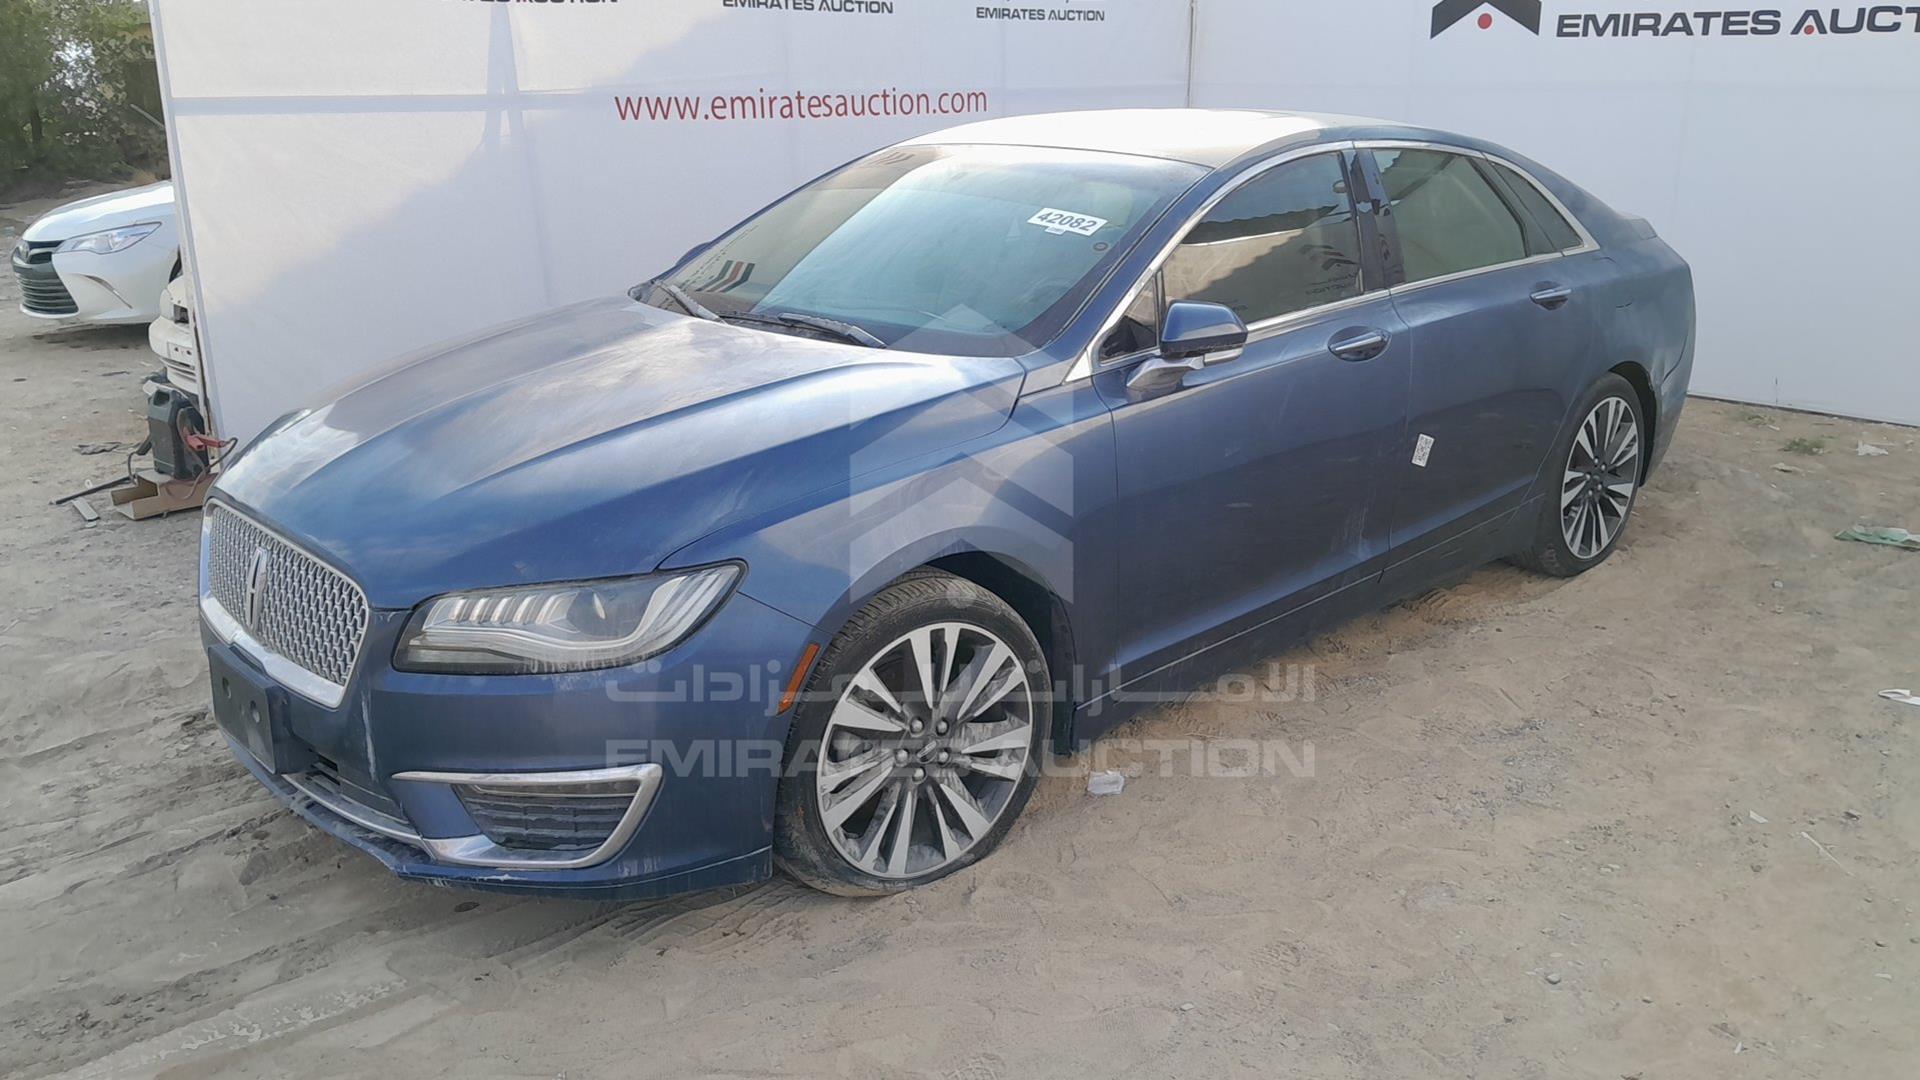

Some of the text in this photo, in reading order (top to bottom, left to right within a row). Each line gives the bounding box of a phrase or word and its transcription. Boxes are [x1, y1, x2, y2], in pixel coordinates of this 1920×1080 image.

[723, 0, 893, 14] EMIRATES AUCTION
[976, 7, 1105, 21] EMIRATES AUCTION
[1555, 9, 1782, 38] EMIRATES
[614, 87, 988, 121] www.emiratesauction.com
[1037, 211, 1098, 232] 42082
